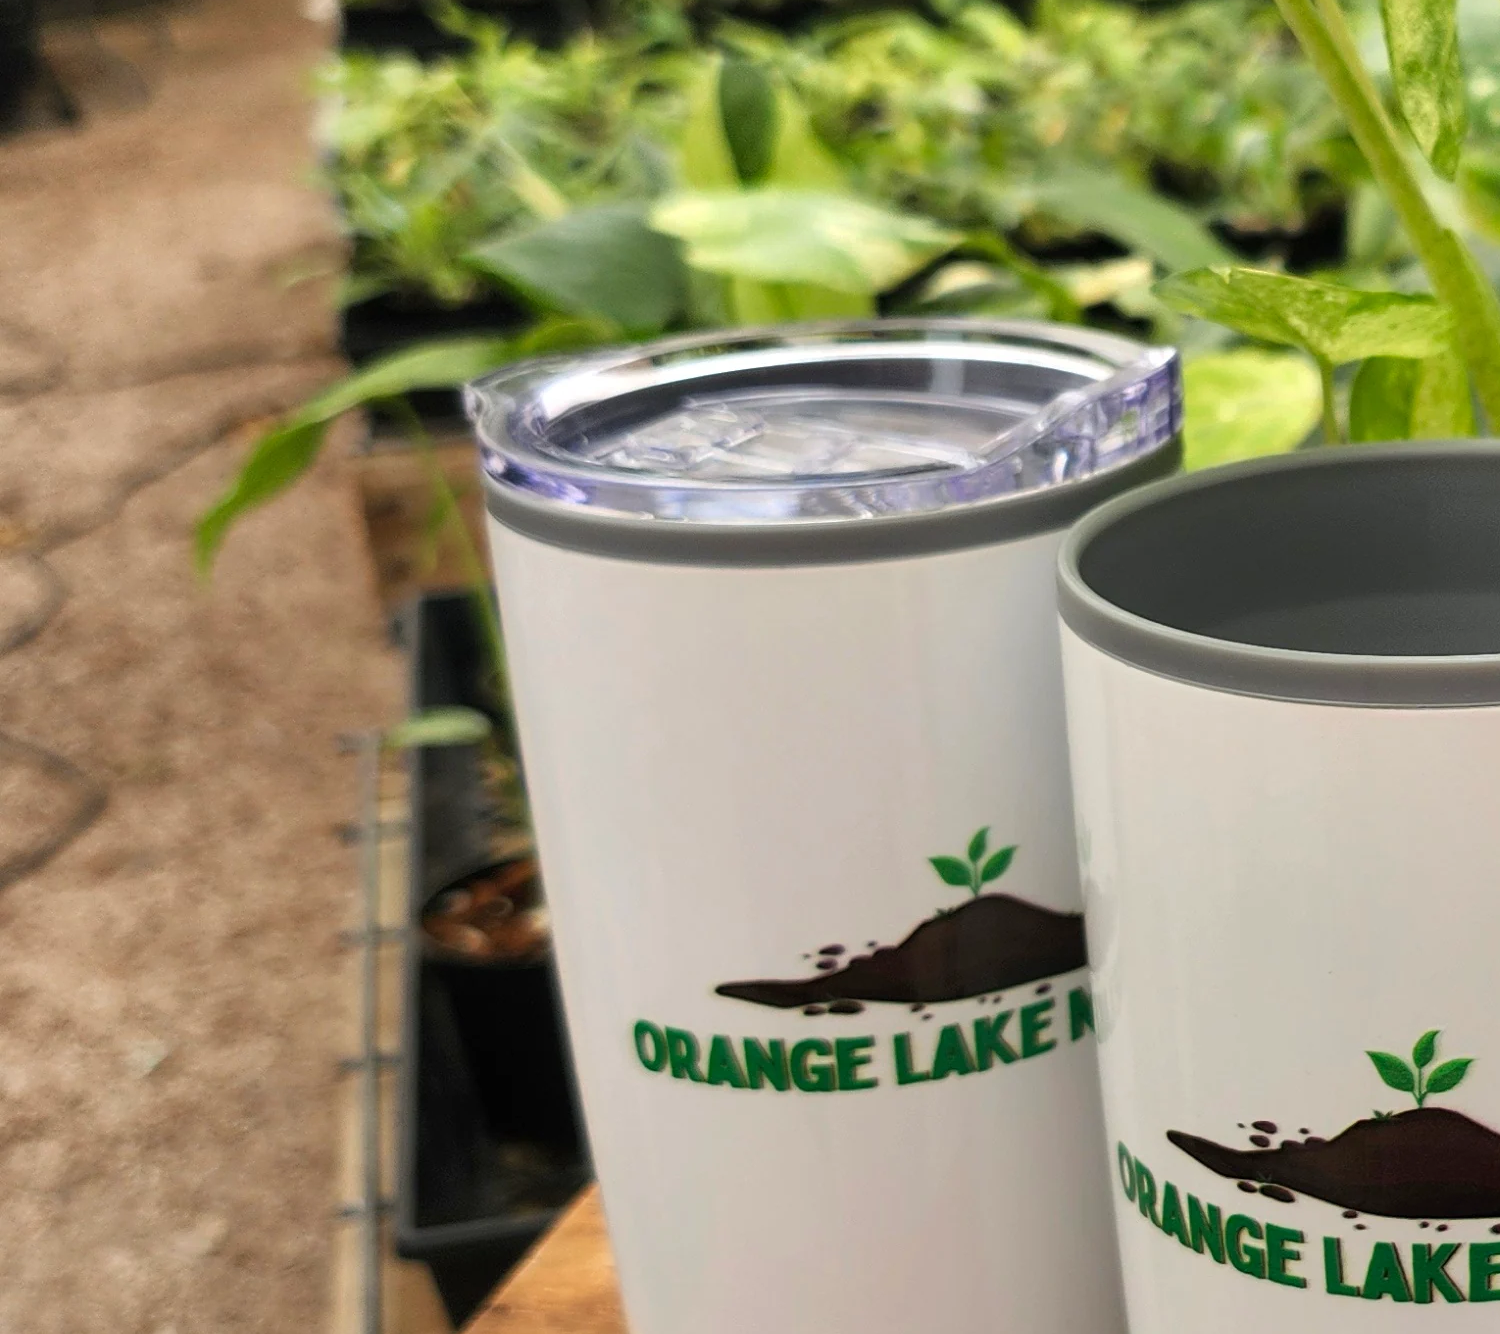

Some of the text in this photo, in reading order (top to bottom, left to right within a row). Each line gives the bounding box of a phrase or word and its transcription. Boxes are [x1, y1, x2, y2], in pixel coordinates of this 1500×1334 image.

[633, 1018, 878, 1093] ORANGE
[892, 998, 1057, 1087] LAKE
[1117, 1140, 1308, 1290] ORANGE
